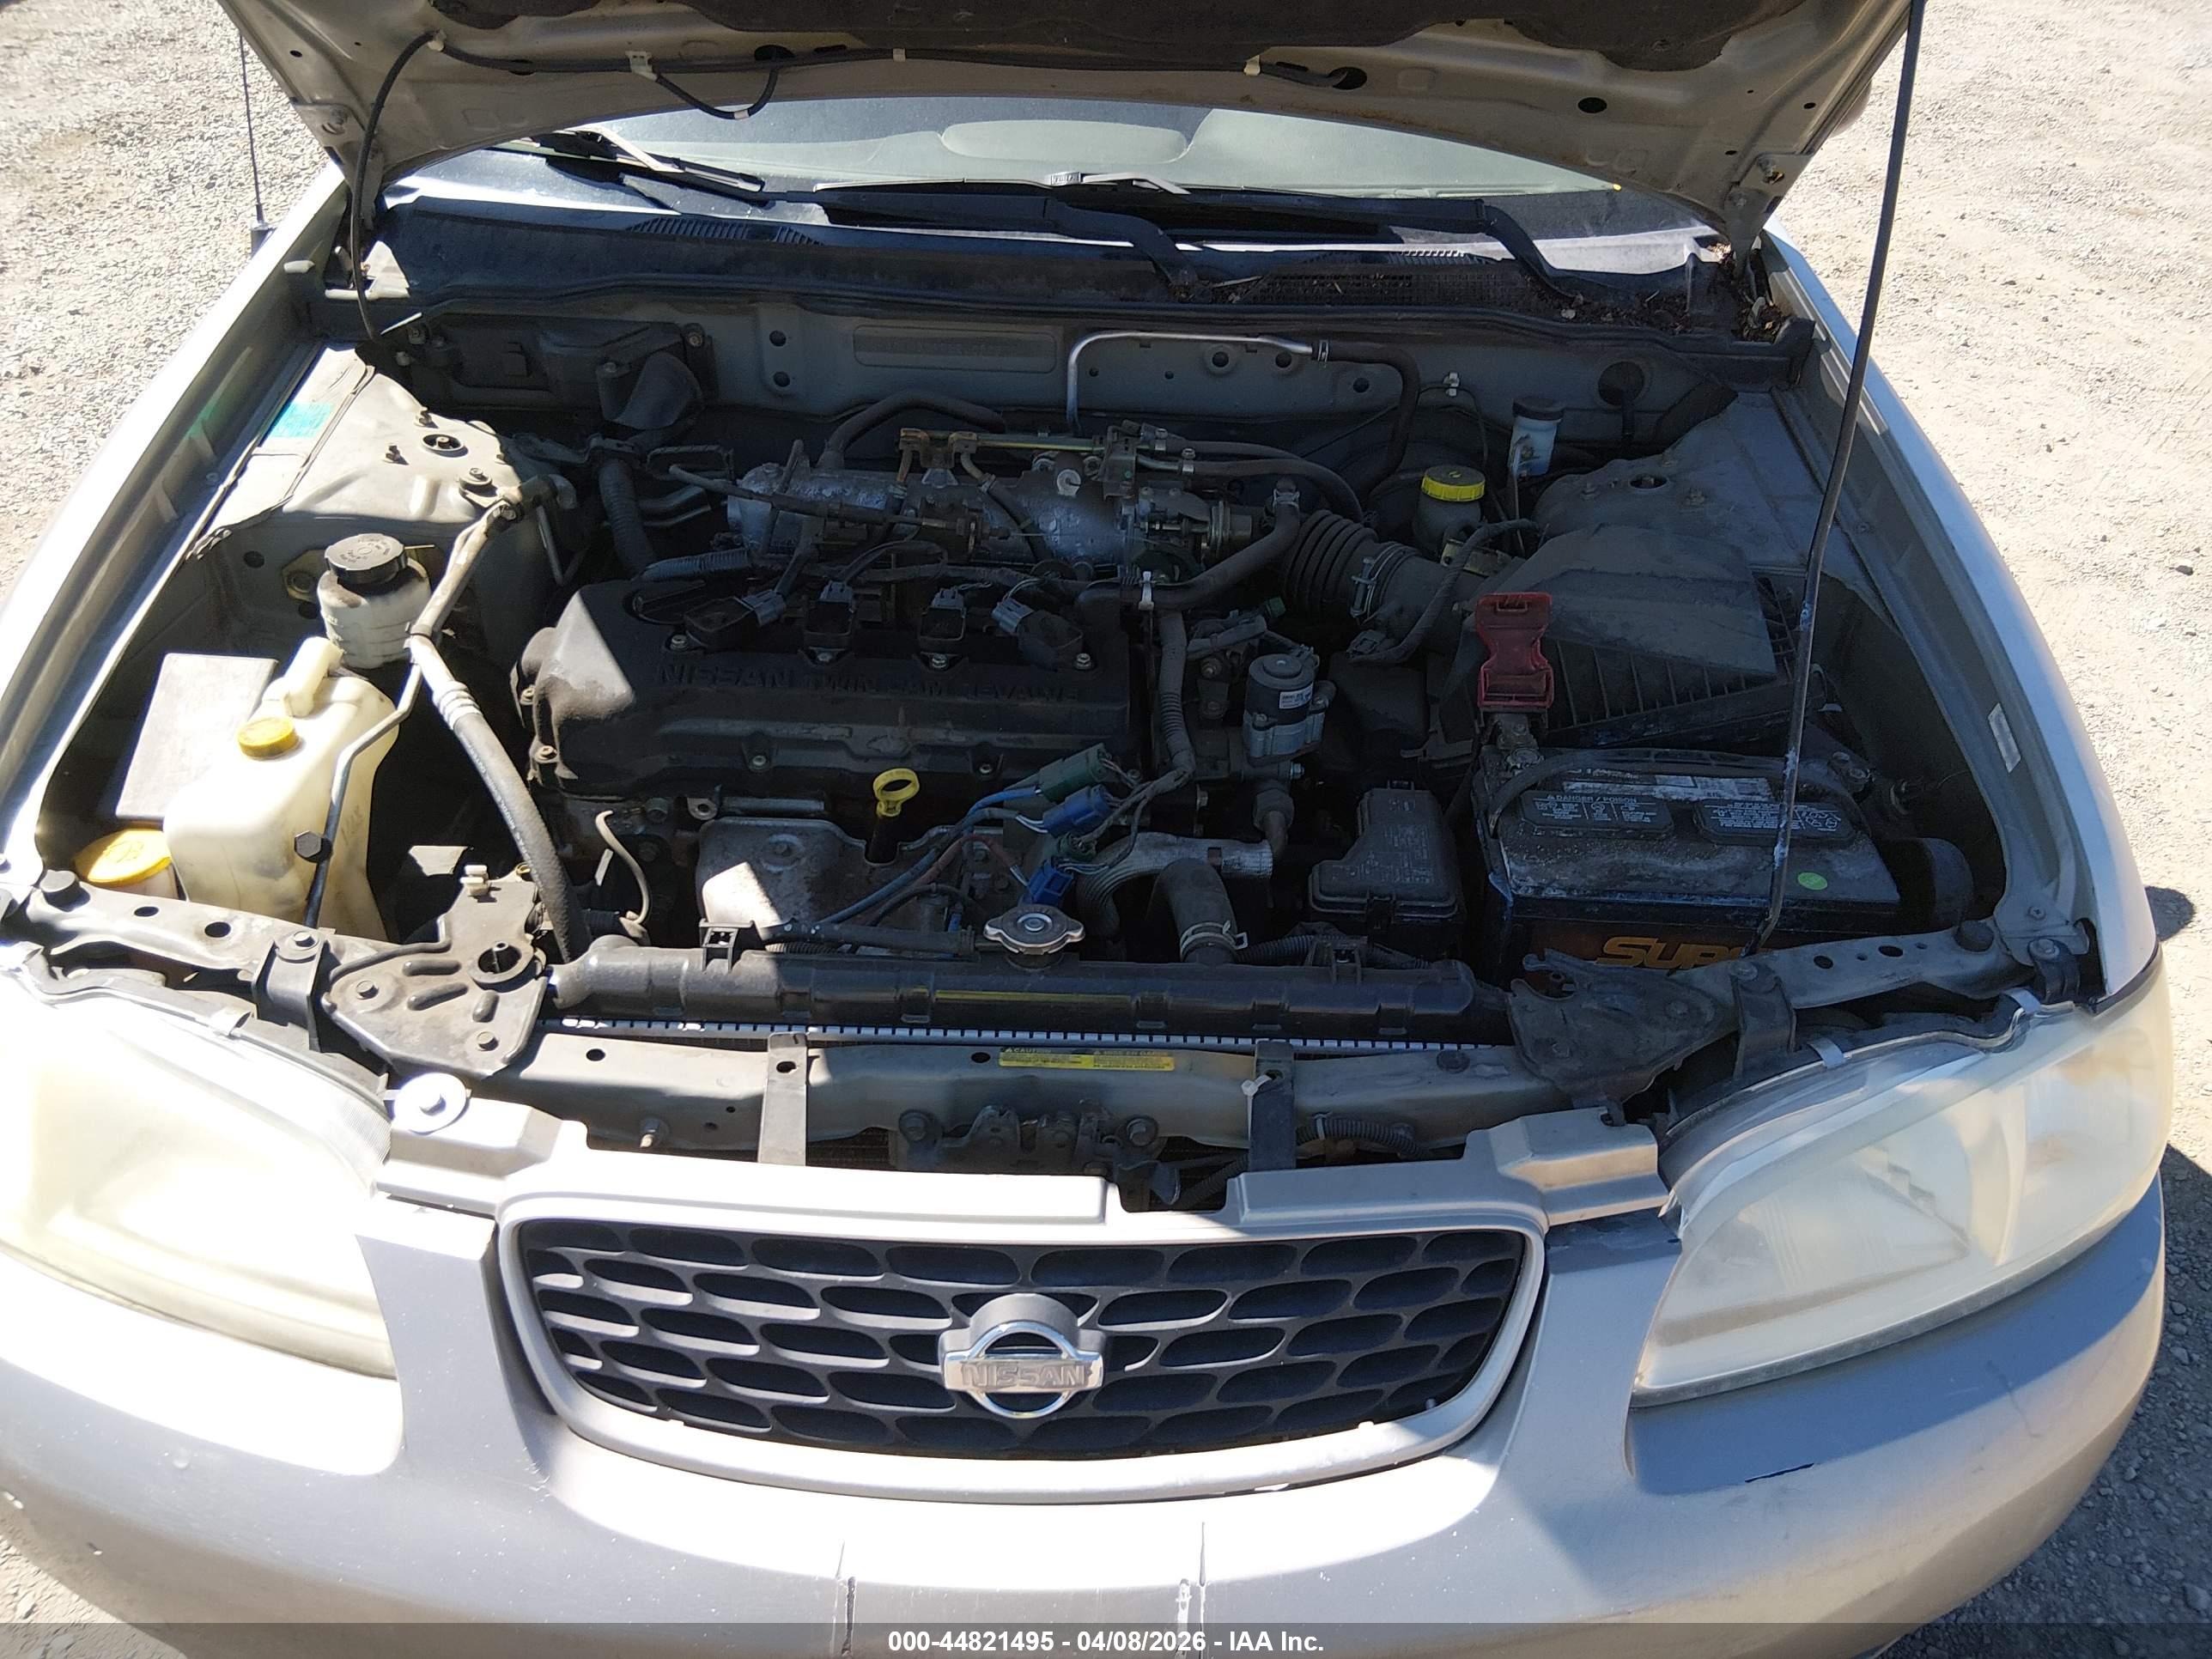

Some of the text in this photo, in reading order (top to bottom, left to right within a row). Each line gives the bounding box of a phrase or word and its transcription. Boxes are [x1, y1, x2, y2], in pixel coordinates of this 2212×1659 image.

[656, 665, 800, 688] NISSAN
[1595, 936, 1742, 969] SUP
[961, 1363, 1087, 1389] NISSAN
